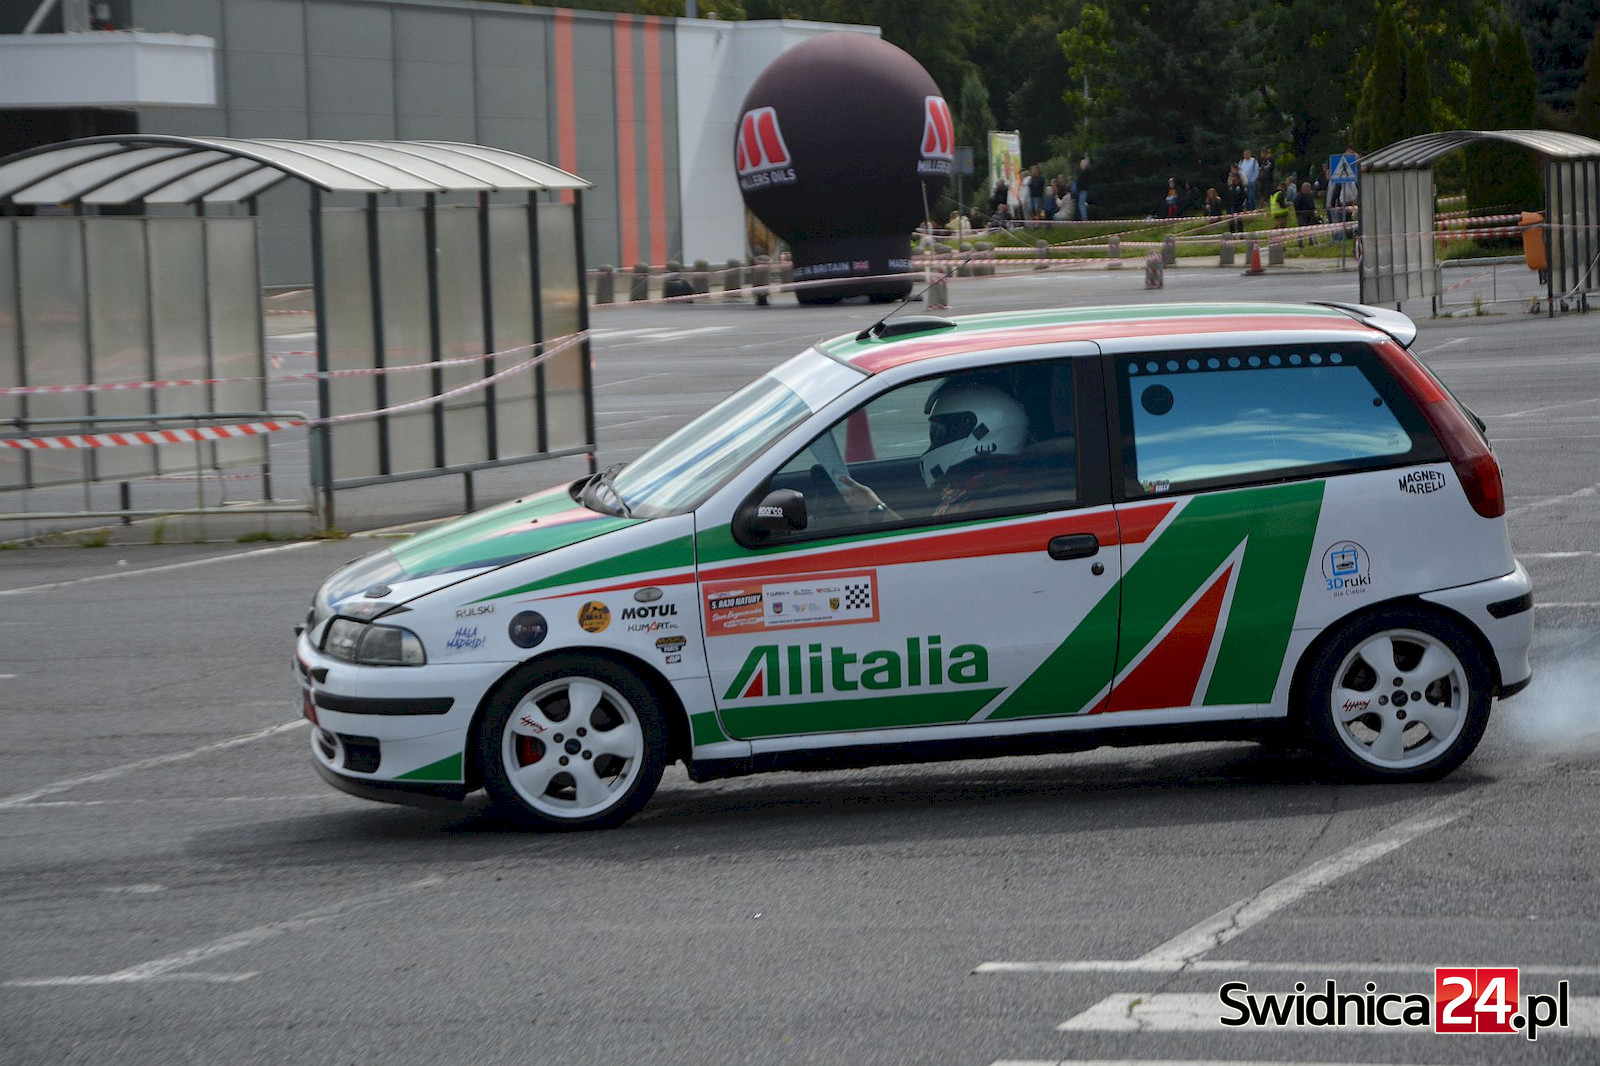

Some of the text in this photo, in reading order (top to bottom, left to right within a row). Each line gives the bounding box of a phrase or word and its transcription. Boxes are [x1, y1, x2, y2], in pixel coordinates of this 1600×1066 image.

[771, 167, 796, 183] OILS
[813, 261, 850, 274] BRITAIN
[1399, 470, 1445, 487] MAGNETI
[1400, 479, 1446, 494] MARELLI
[758, 506, 783, 515] sparco
[1325, 573, 1371, 591] 3Druki
[735, 594, 761, 606] NATURY
[621, 604, 678, 620] MOTUL
[455, 627, 478, 638] HALA
[446, 636, 486, 649] MADRID!
[722, 635, 989, 699] Alitalia
